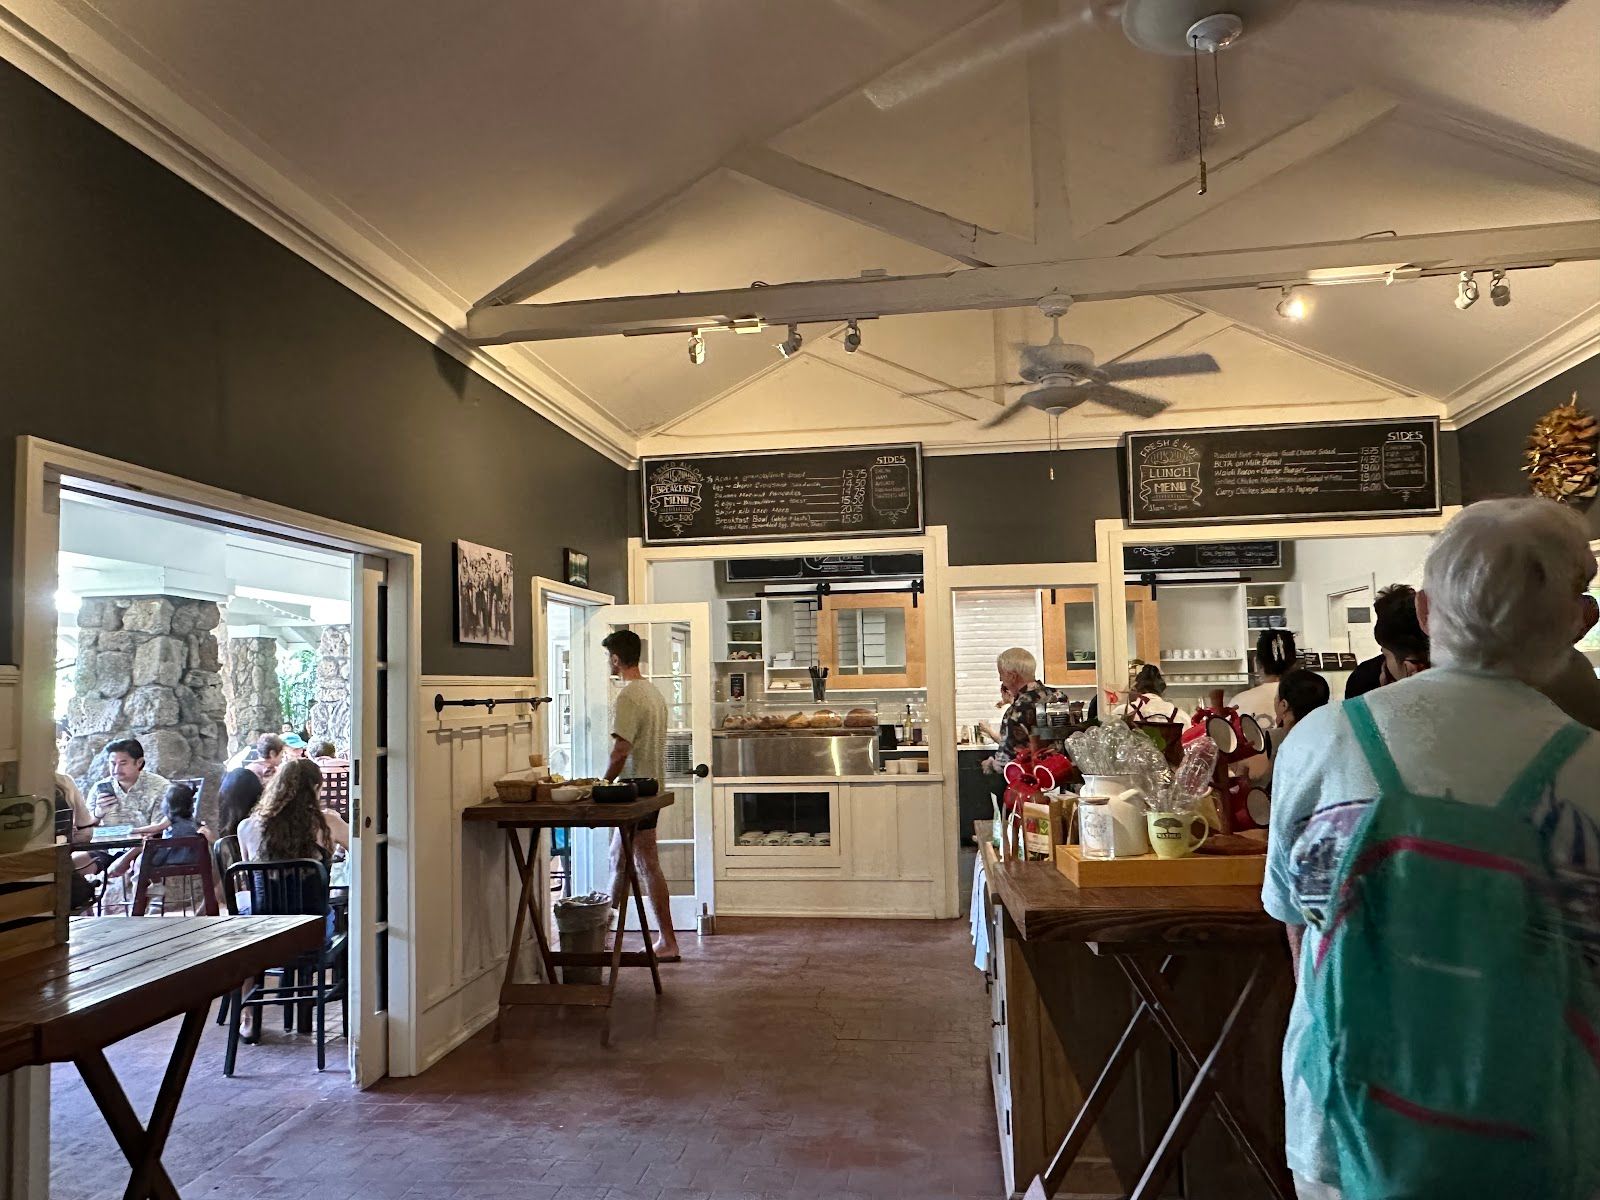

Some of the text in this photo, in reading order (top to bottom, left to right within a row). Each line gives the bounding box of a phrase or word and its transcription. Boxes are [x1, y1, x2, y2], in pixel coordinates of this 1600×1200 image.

[1387, 431, 1424, 440] SIDES
[1140, 440, 1170, 458] FRESH
[1182, 442, 1199, 457] HOT
[876, 456, 907, 464] SIDES
[842, 469, 868, 479] 13.75
[1149, 466, 1192, 478] LUNCH
[655, 484, 696, 495] BREAKFAST
[1154, 481, 1187, 494] MENU
[663, 496, 690, 505] MENU
[715, 516, 750, 525] Breakfast
